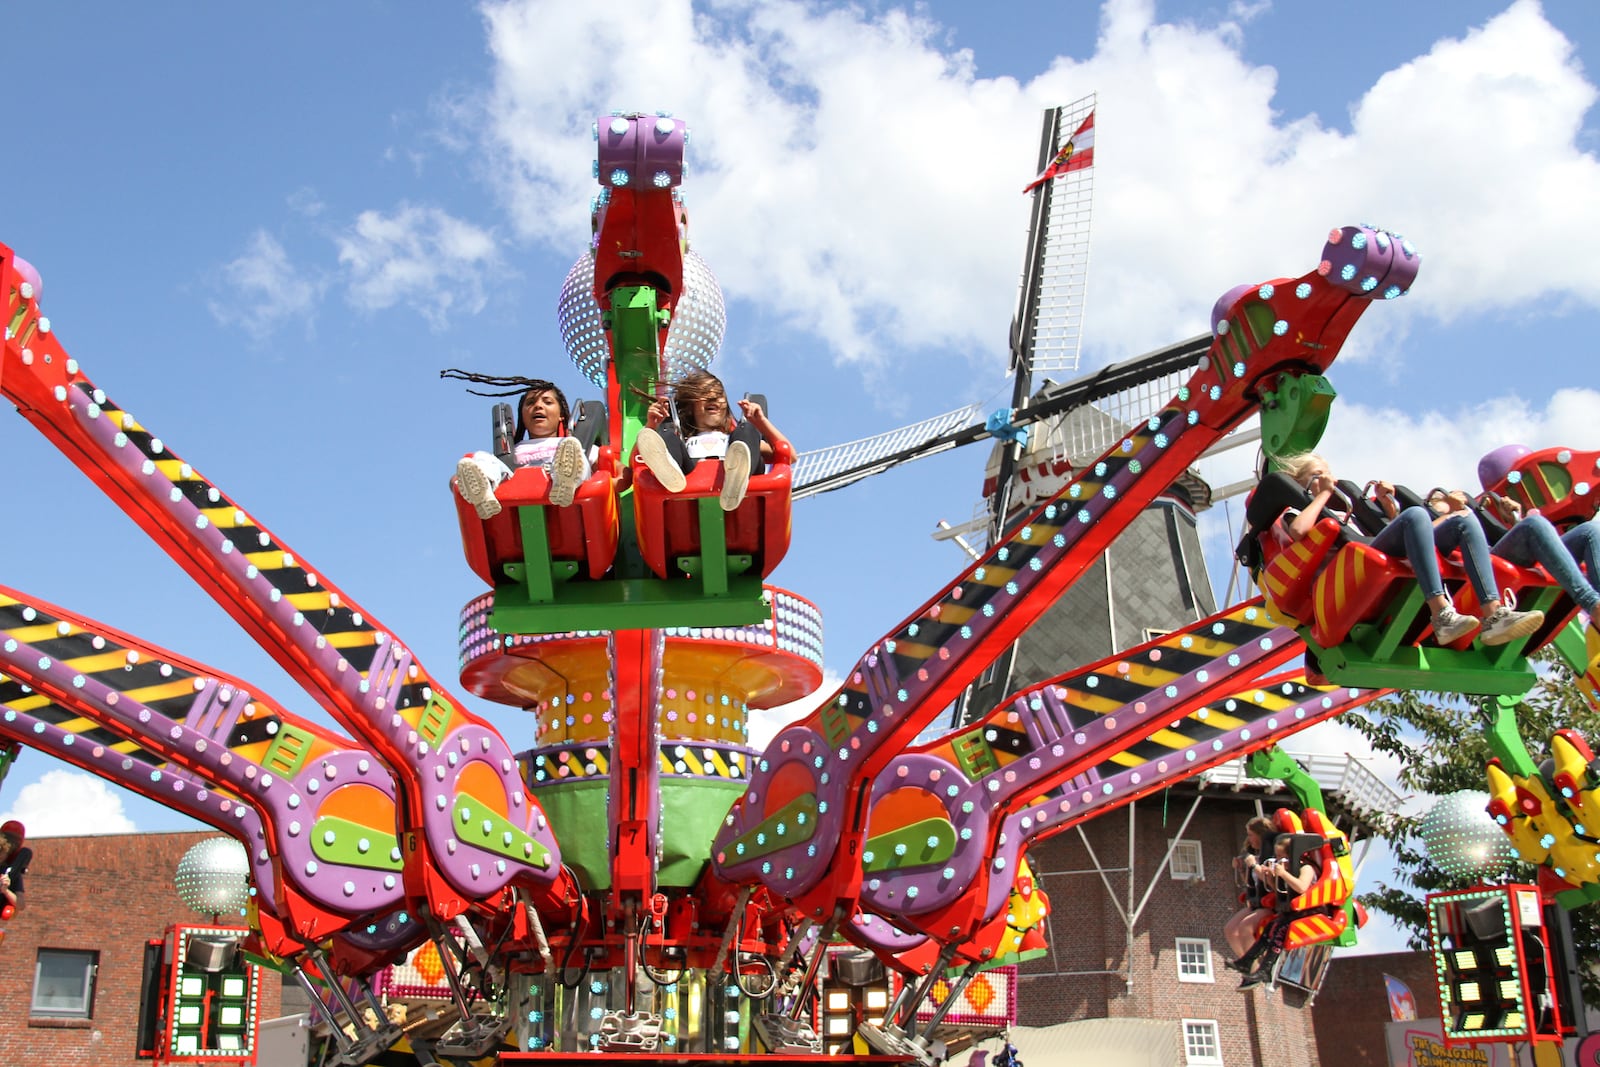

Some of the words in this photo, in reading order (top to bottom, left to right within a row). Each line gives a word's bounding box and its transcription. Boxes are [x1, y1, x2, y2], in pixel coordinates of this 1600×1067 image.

[409, 835, 417, 852] 6
[629, 828, 638, 846] 7
[849, 839, 857, 856] 8
[1431, 1043, 1487, 1062] ORIGINAL
